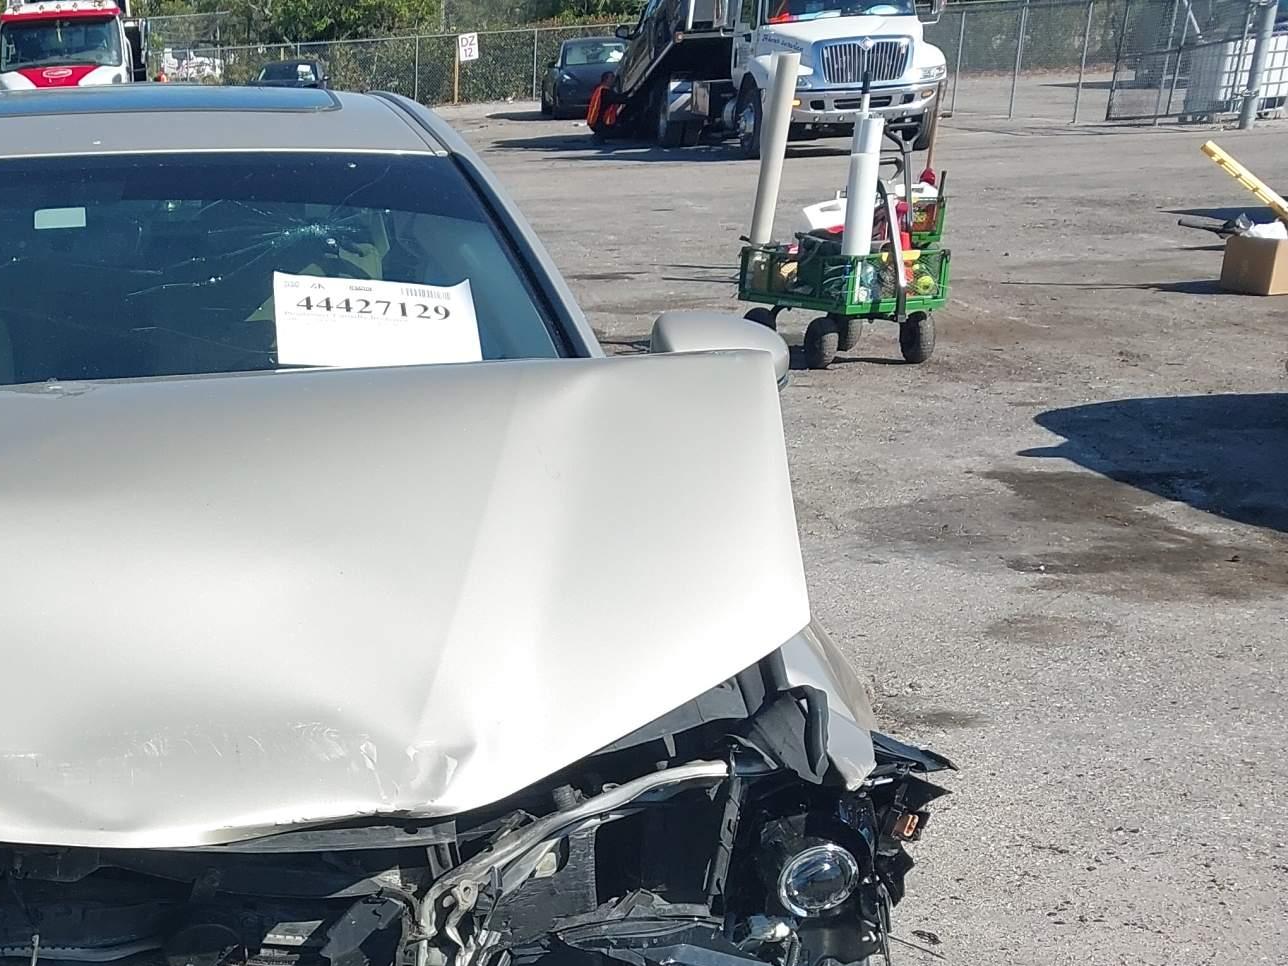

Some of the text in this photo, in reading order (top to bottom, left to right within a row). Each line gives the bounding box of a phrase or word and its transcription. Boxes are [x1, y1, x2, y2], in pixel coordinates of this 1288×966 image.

[461, 36, 476, 48] DZ
[464, 48, 473, 58] 12
[296, 296, 450, 320] 44427129
